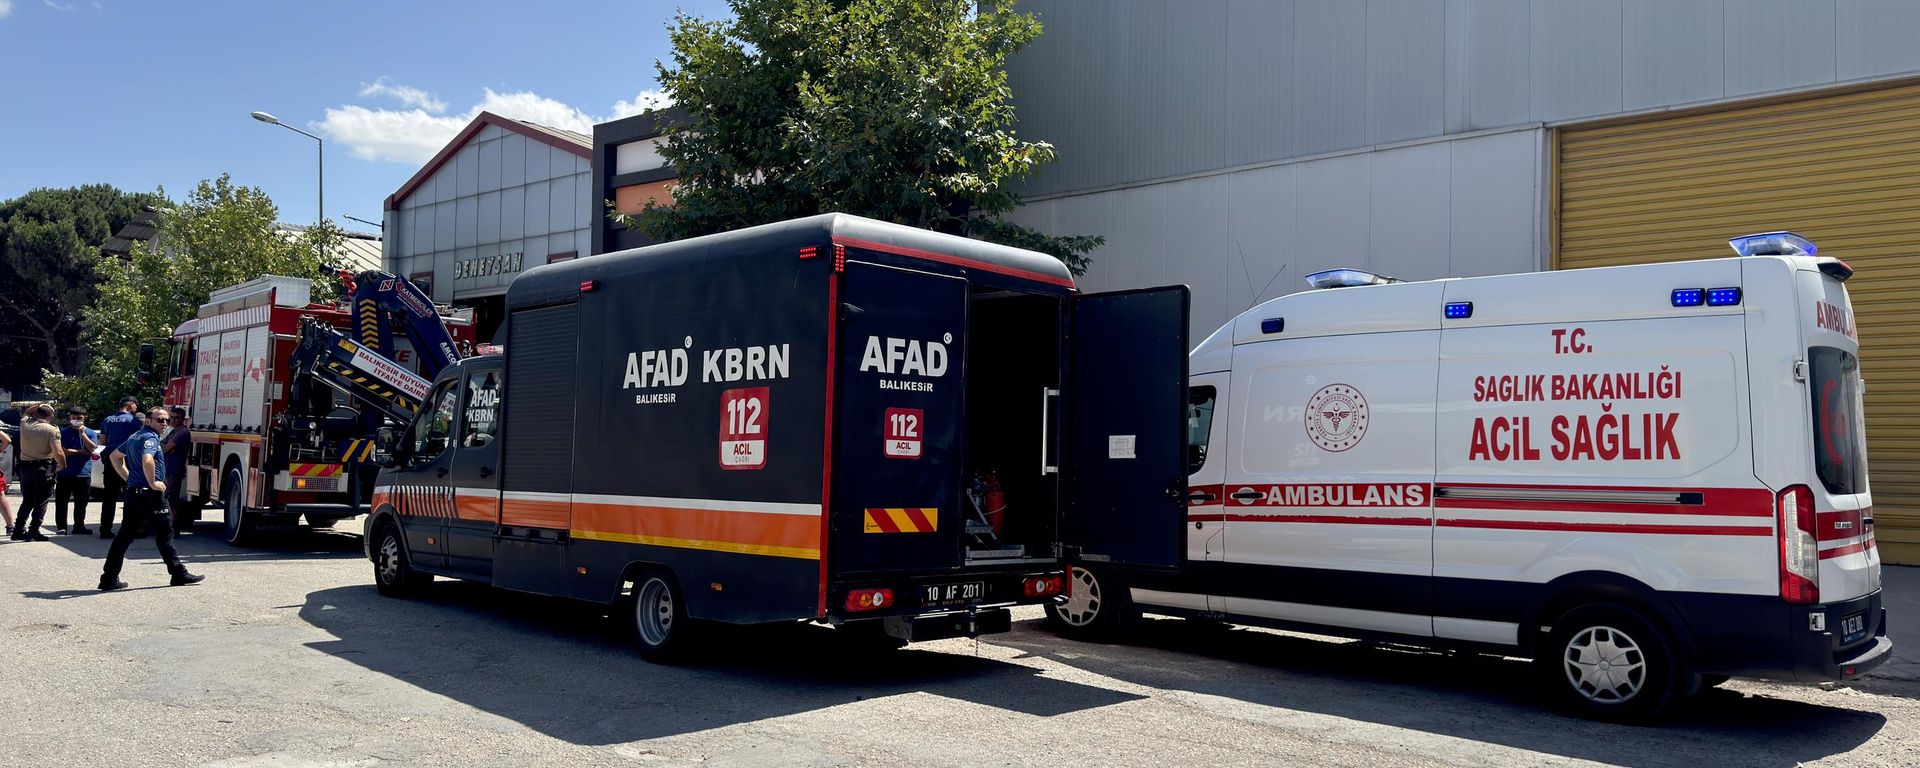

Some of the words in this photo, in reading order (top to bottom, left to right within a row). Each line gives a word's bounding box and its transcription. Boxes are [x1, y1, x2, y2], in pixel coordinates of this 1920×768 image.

[455, 253, 523, 280] DENEYSAN
[1551, 328, 1593, 354] T.C.
[358, 351, 399, 376] BALIKESİR
[623, 348, 689, 389] AFAD
[702, 343, 790, 383] KBRN
[860, 335, 948, 377] AFAD
[1551, 365, 1682, 401] BAKANLIĞI
[470, 389, 497, 407] AFAD
[468, 409, 494, 422] KBRN
[727, 397, 762, 435] 112
[891, 413, 918, 437] 112
[1551, 403, 1681, 461] SAĞLIK
[1267, 485, 1424, 506] AMBULANS
[928, 587, 939, 601] 10
[946, 585, 958, 600] AF
[962, 584, 979, 598] 201
